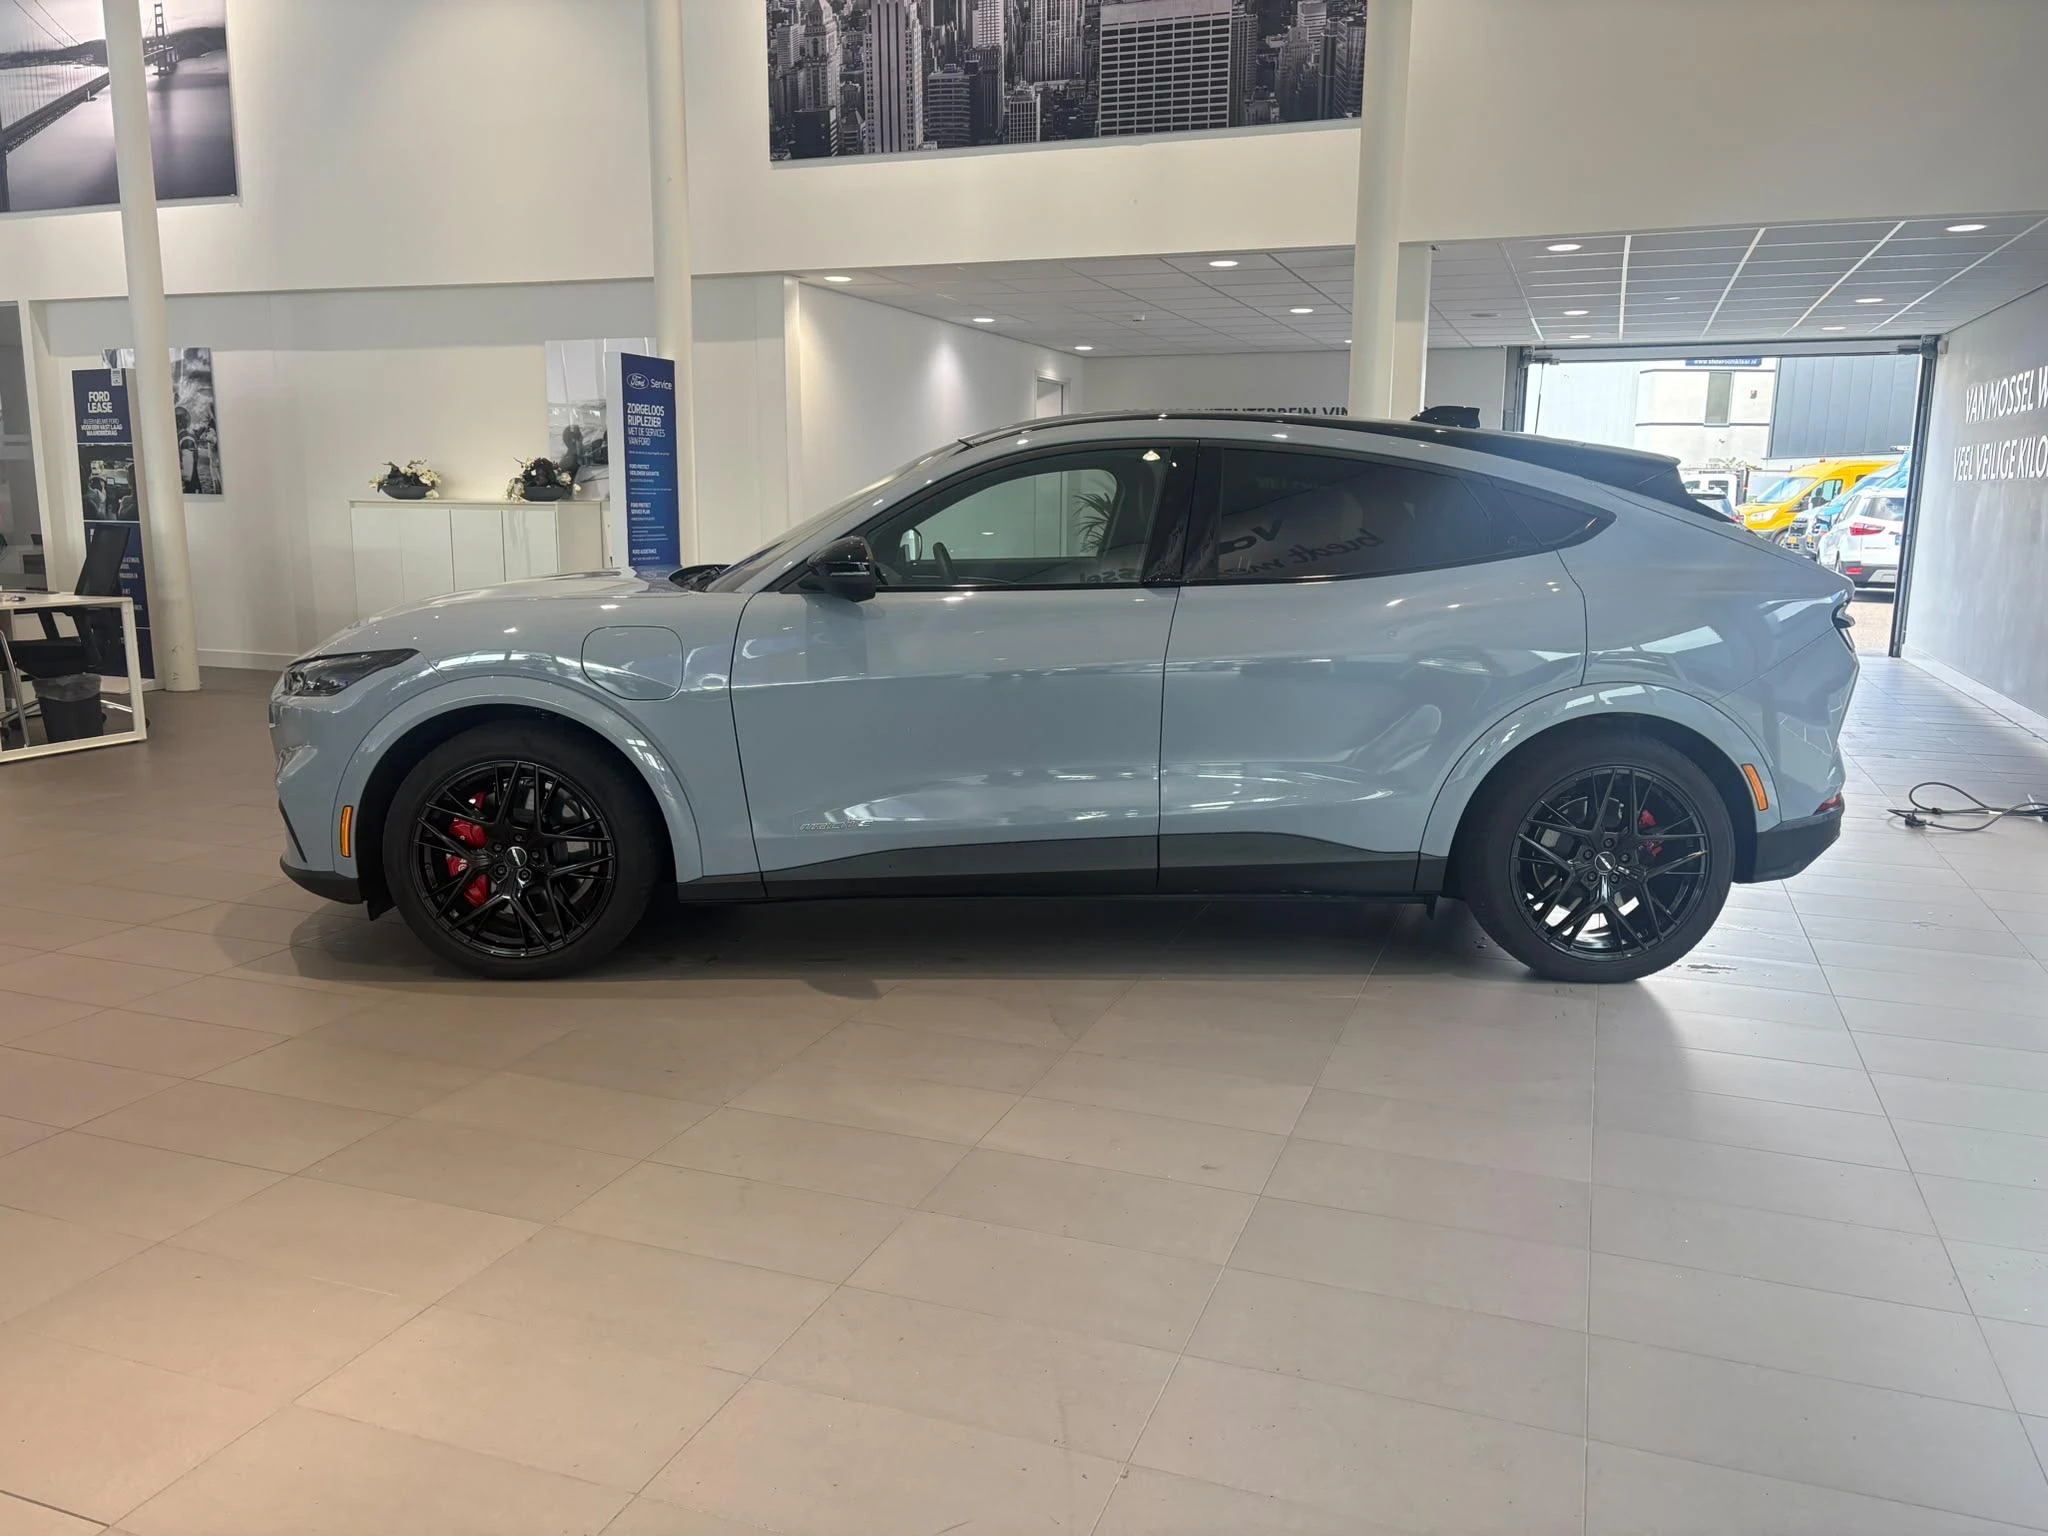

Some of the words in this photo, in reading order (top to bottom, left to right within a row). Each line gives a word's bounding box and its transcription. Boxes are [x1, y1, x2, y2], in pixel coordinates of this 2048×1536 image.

[650, 378, 673, 390] Service
[88, 391, 110, 402] FORD
[1965, 384, 1989, 424] VAN
[1988, 369, 2035, 419] MOSSEL
[88, 402, 113, 413] LEASE
[627, 403, 665, 416] ZORGELOOS
[1953, 445, 1974, 481] VEEL
[1976, 439, 2018, 481] VEILIGE
